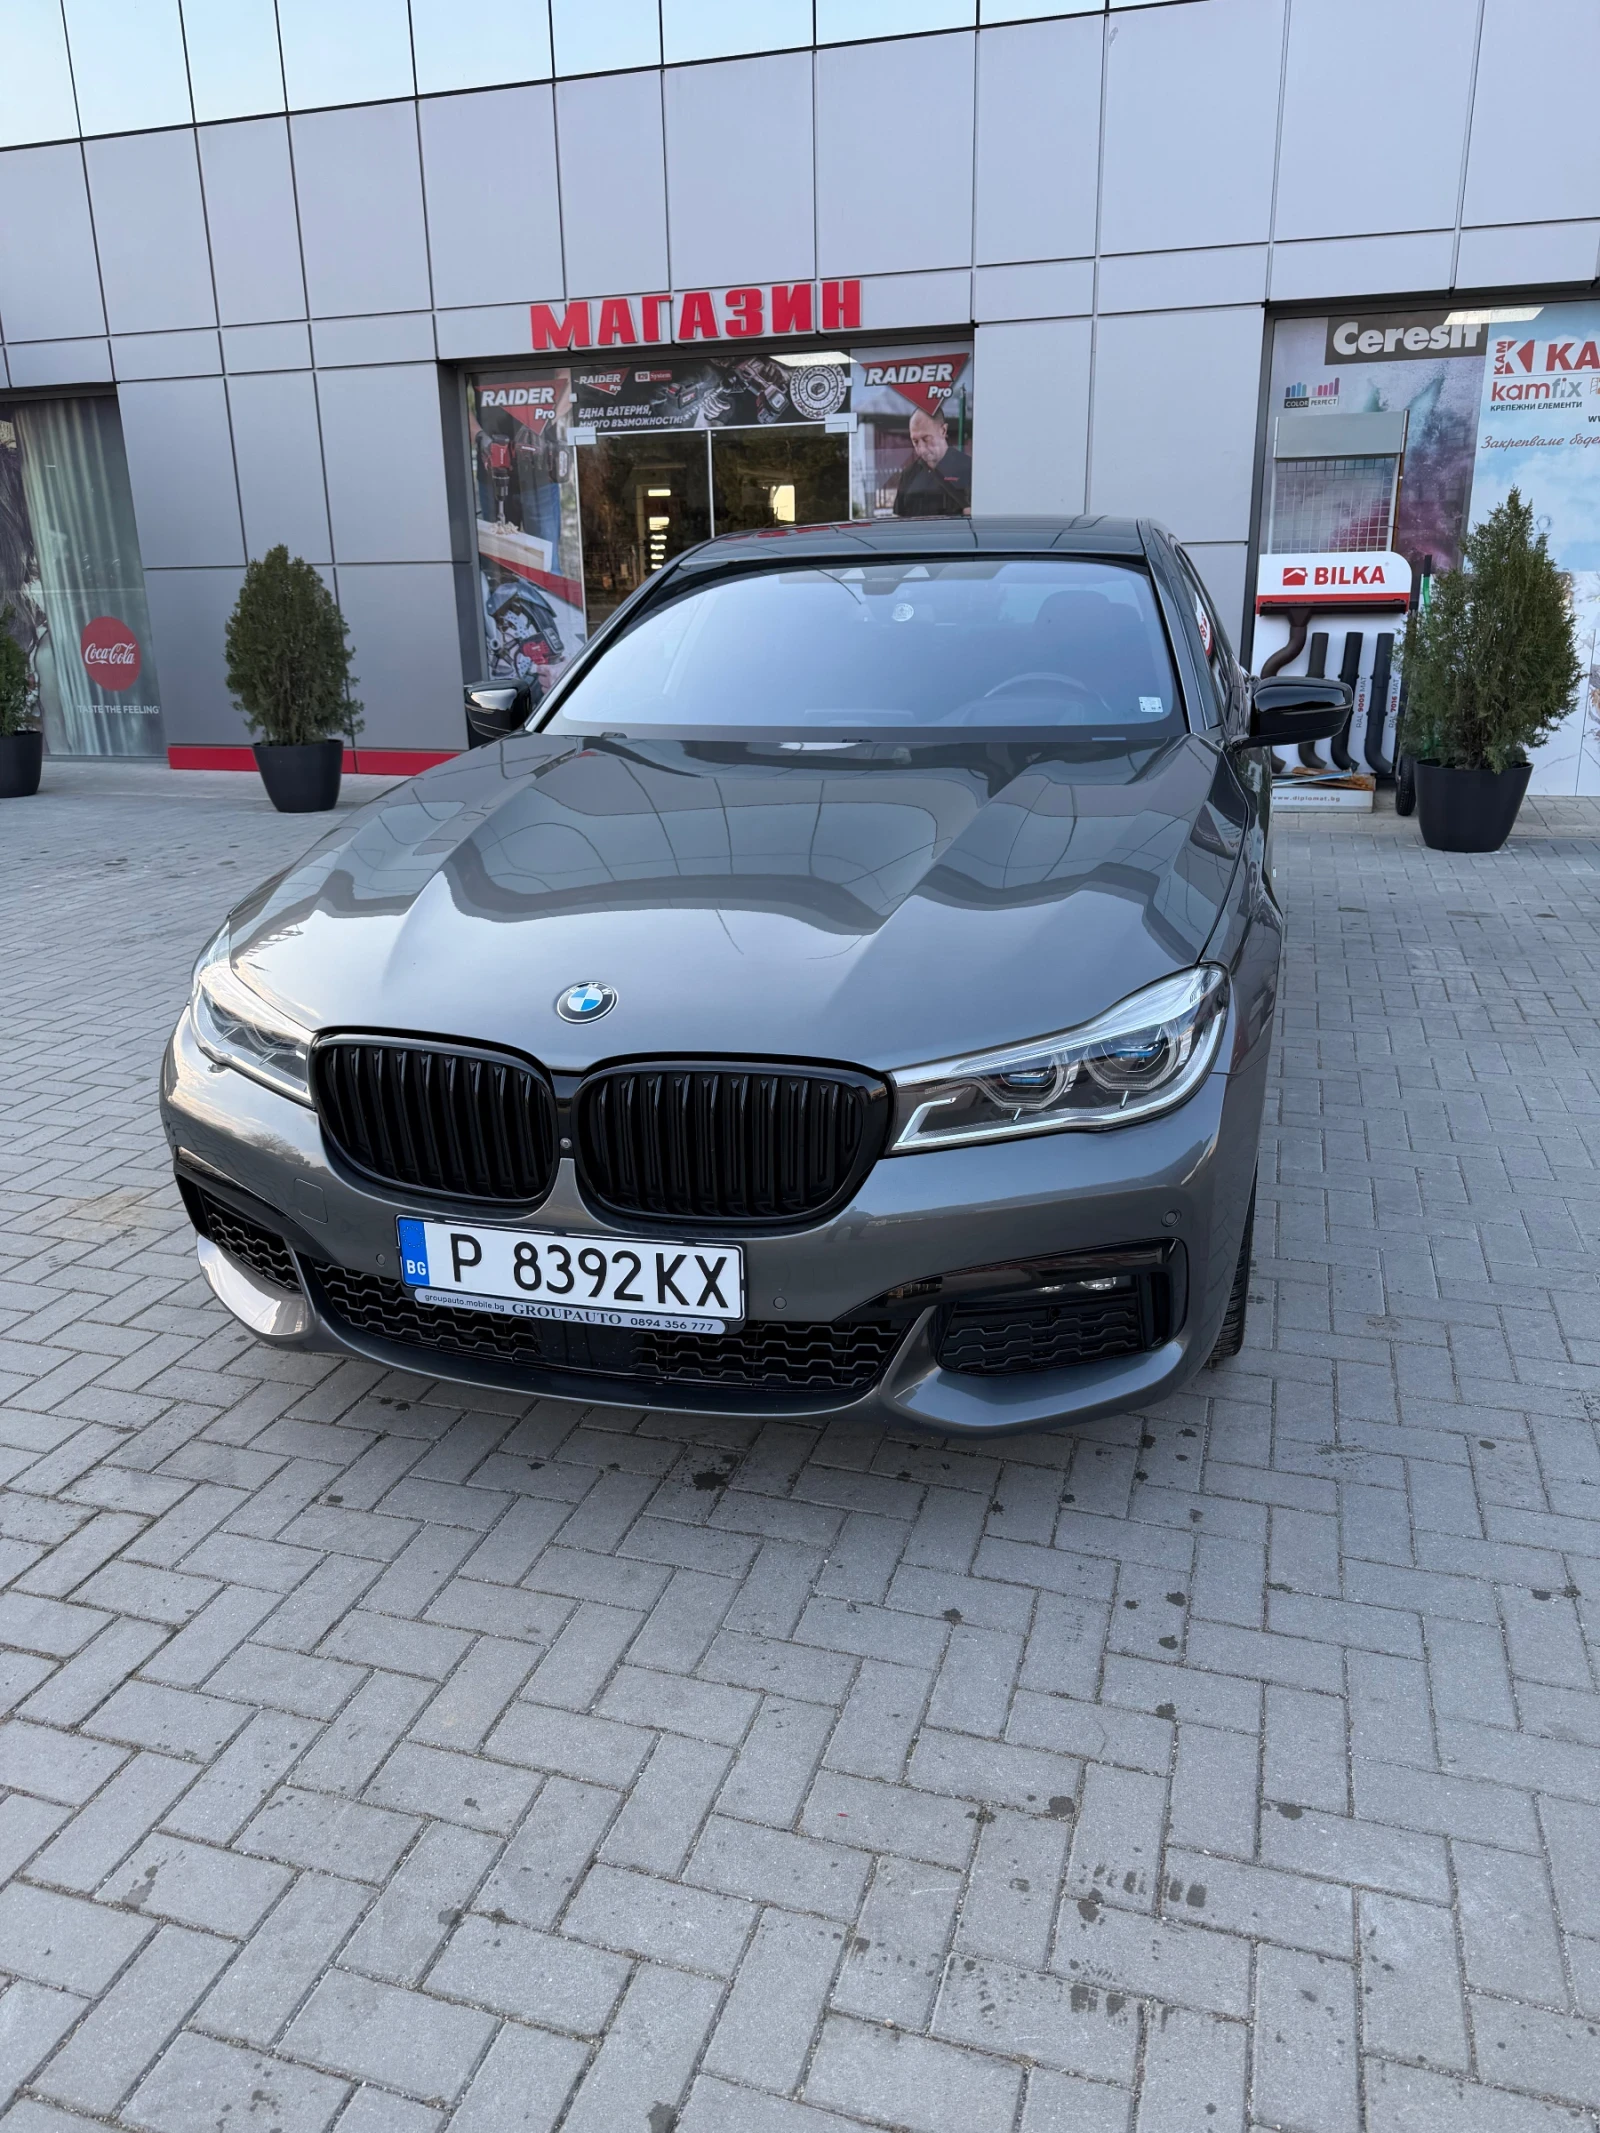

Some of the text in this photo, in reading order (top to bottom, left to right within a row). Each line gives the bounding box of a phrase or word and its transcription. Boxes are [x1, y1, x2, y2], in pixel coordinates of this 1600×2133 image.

[530, 280, 861, 350] МАГАЗИН
[1333, 321, 1482, 356] Ceresit
[1494, 341, 1507, 374] KAM
[579, 374, 621, 384] RAIDER
[866, 364, 952, 386] RAIDER
[481, 388, 554, 407] RAIDER
[928, 386, 952, 398] Pro
[1491, 378, 1583, 401] kamfix
[578, 405, 652, 419] ЕДНА БАТЕРИЯ,
[1285, 398, 1337, 408] COLOR PERFECT
[1490, 403, 1536, 411] КРЕПЕЖНИ
[535, 409, 555, 420] Pro
[1314, 565, 1385, 585] BILKA
[85, 643, 136, 665] Coca-Cola
[1392, 679, 1400, 695] MAT
[78, 705, 159, 714] TASTE THE FEELING
[1355, 676, 1367, 728] RAL 9005 MAT
[1390, 695, 1398, 713] 7016
[406, 1259, 427, 1276] BG
[450, 1233, 483, 1283] P
[424, 1294, 714, 1332] groupauto.mobile.bg GROUPAUTO 0894 356 777
